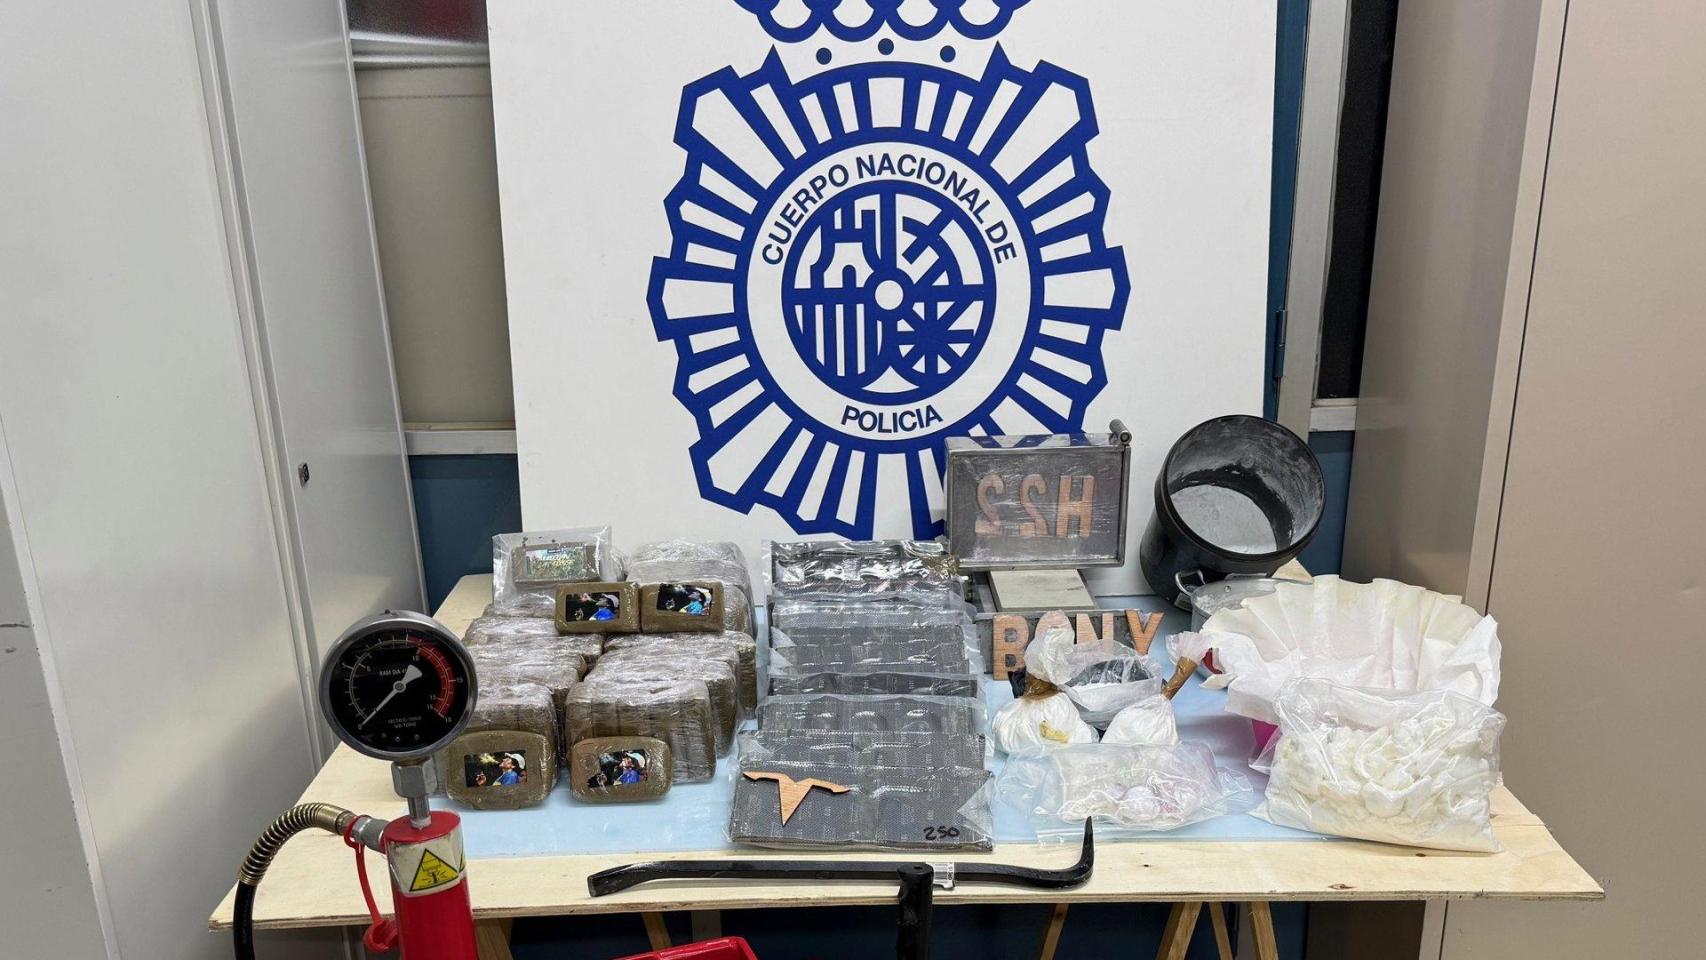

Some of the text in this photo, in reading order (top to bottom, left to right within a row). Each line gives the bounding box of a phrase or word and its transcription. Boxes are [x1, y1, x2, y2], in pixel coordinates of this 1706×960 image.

[762, 153, 1017, 266] CUERPO NACIONAL DE
[841, 404, 943, 434] POLICIA
[923, 826, 961, 841] 250
